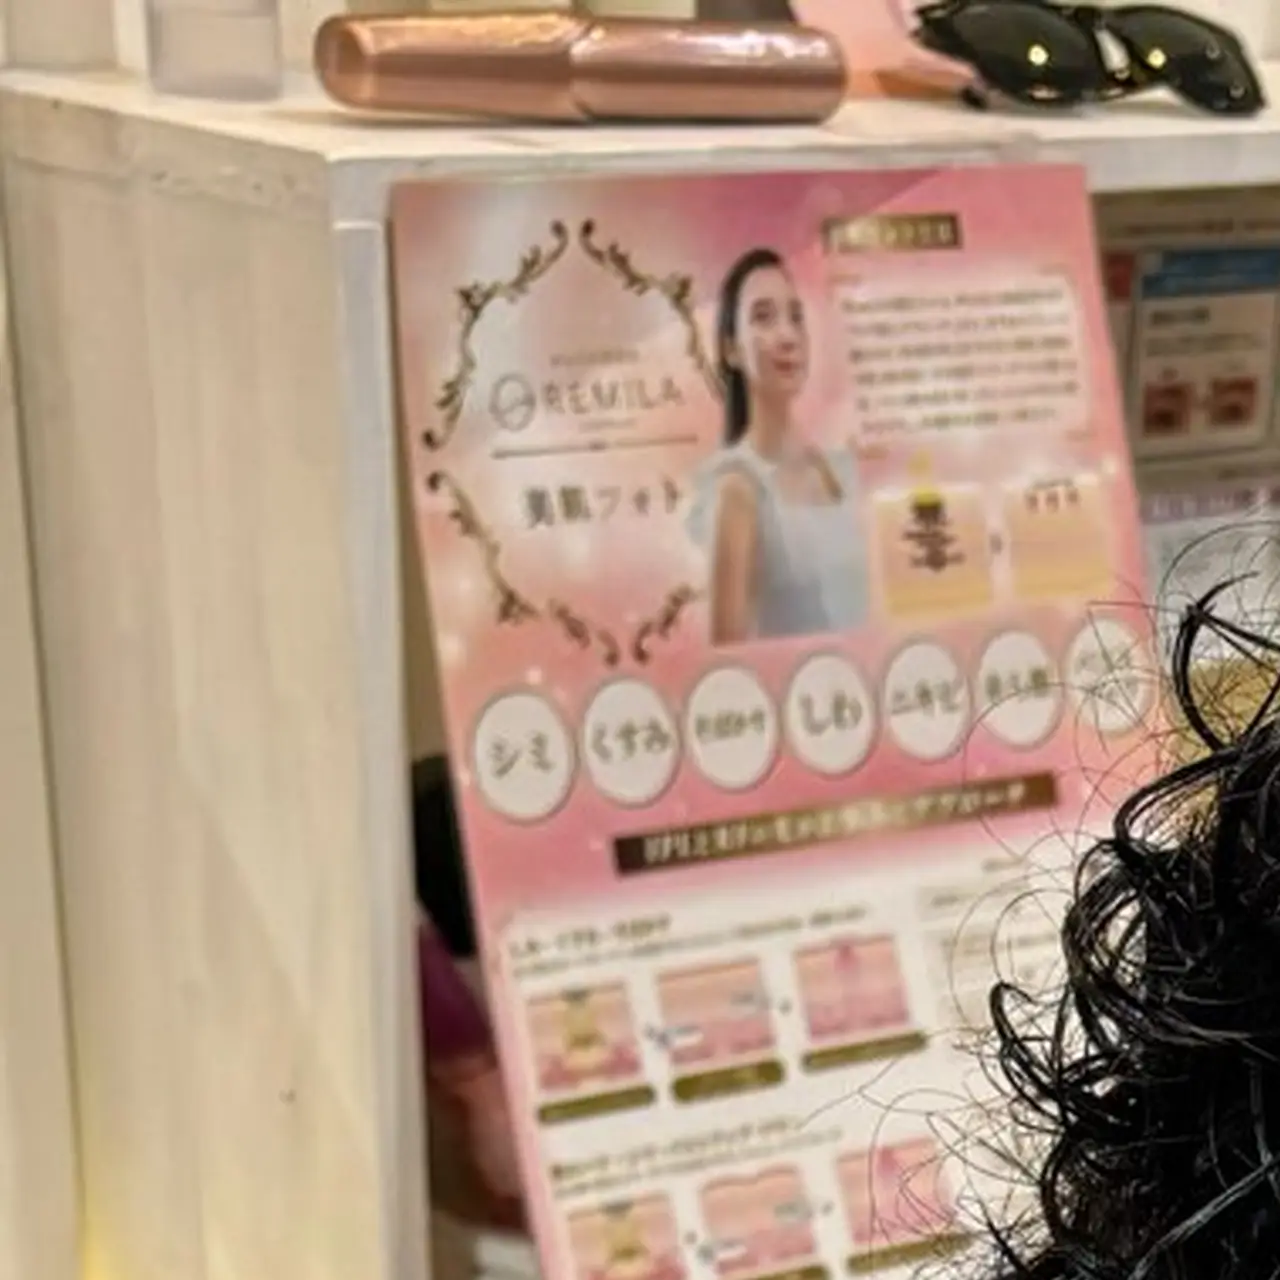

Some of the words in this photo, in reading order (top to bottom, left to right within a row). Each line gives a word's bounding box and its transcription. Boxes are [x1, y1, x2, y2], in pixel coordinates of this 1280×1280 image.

[800, 693, 862, 735] しわ
[490, 731, 555, 779] シミ
[591, 716, 671, 764] くすみ
